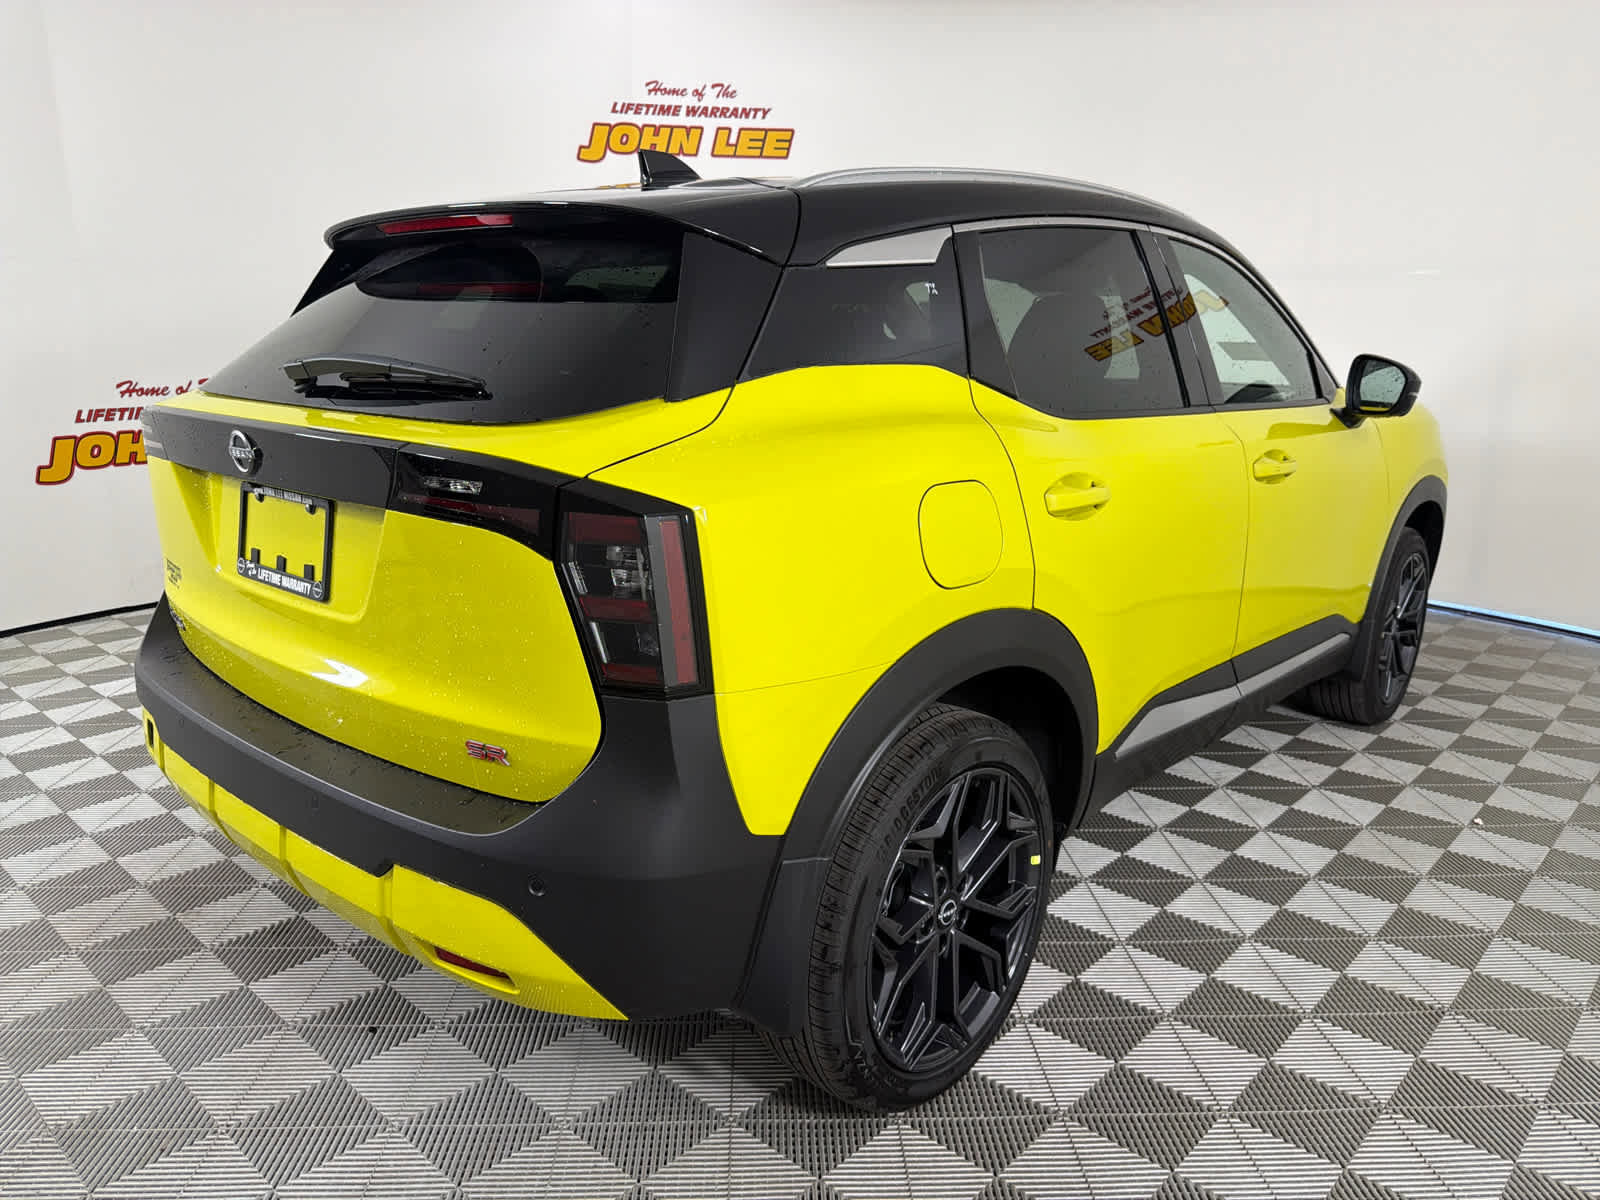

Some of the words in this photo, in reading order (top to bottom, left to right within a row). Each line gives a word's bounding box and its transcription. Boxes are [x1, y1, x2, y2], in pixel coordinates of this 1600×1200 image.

[645, 80, 688, 98] Home
[692, 83, 706, 103] of
[711, 83, 738, 99] The
[611, 102, 682, 117] LIFETIME
[685, 105, 772, 120] WARRANTY
[577, 122, 703, 163] JOHN
[711, 127, 795, 160] LEE
[116, 379, 170, 398] Home
[75, 406, 145, 424] LIFETI
[35, 429, 148, 485] JOH
[257, 568, 281, 586] LIFETIME
[281, 575, 312, 596] WARRANTY
[465, 739, 510, 766] SR
